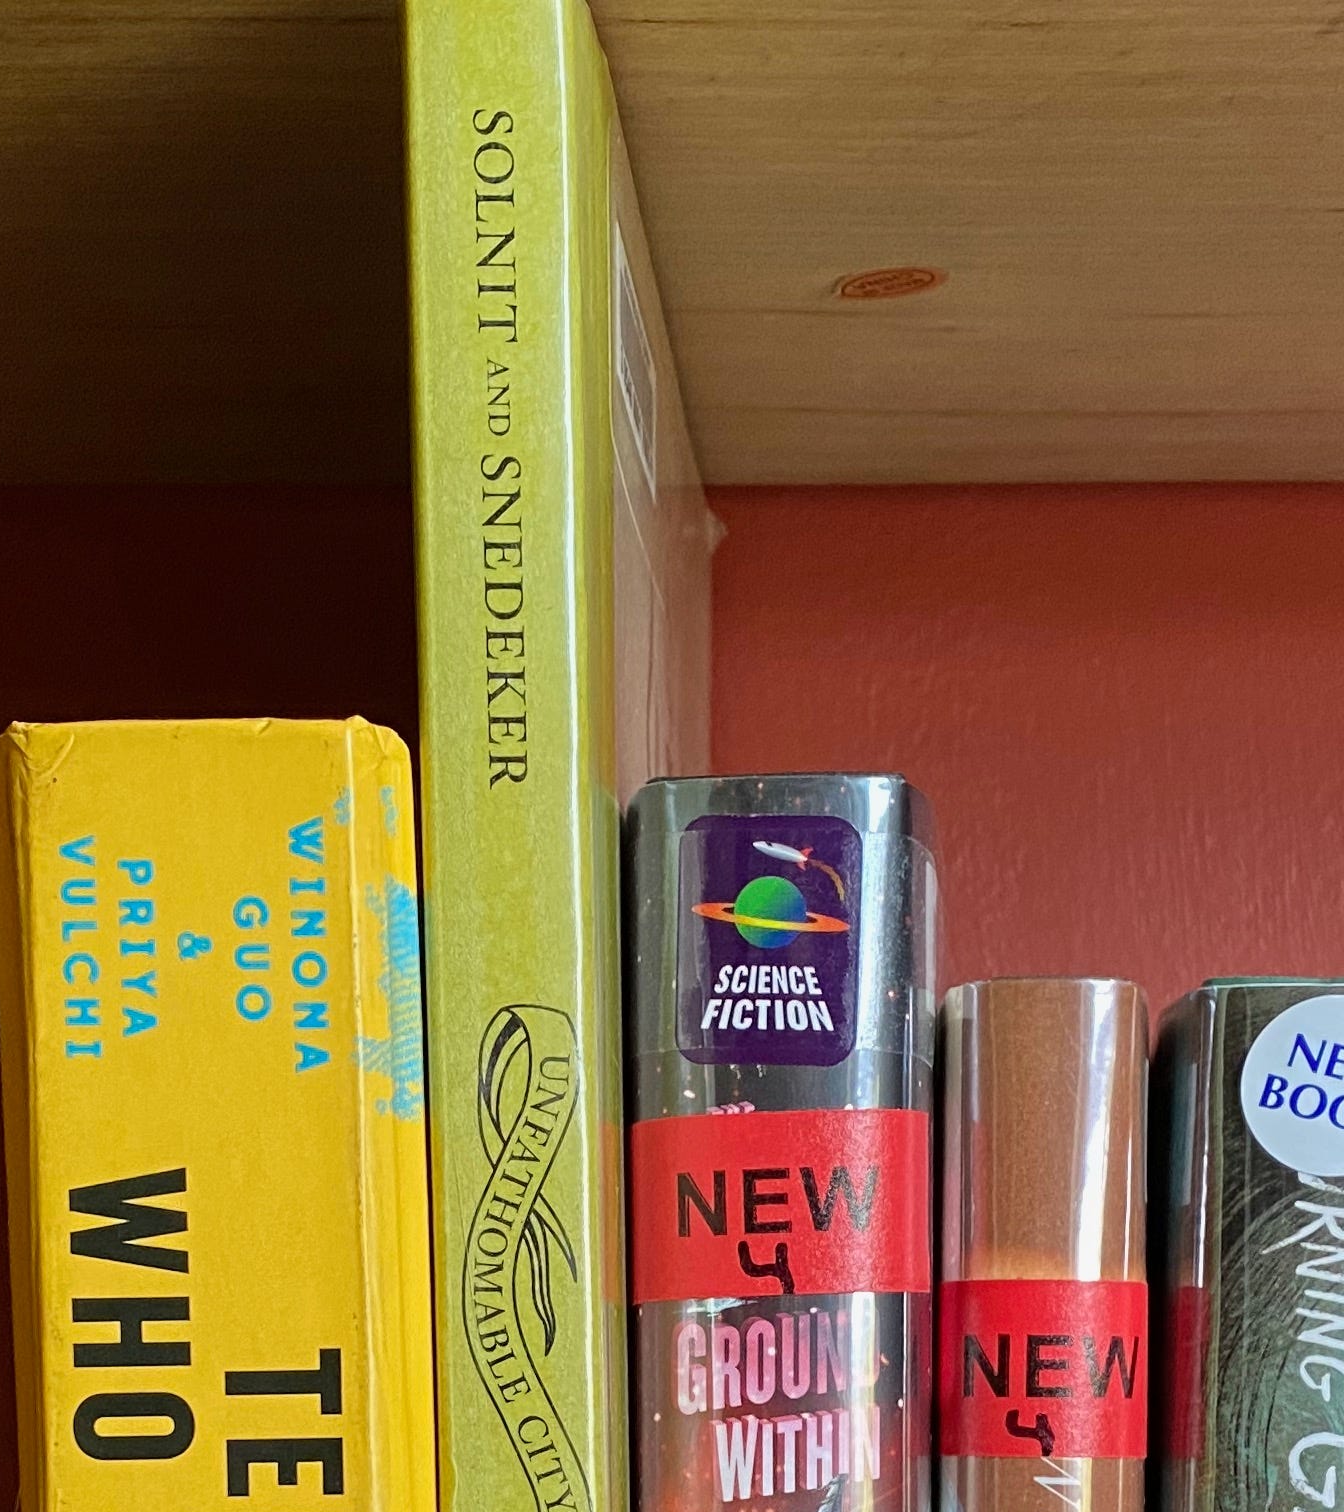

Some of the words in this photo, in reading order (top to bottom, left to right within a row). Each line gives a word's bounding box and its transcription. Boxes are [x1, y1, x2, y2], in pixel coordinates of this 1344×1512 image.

[471, 108, 519, 344] SOLNIT
[486, 358, 511, 437] AND
[479, 453, 528, 787] SNEDEKER
[58, 834, 103, 1059] VULCHI
[117, 858, 157, 1037] PRIYA
[176, 931, 213, 960] &
[233, 896, 272, 1023] GUO
[288, 816, 329, 1073] WINONA
[714, 963, 822, 996] SCIENCE
[700, 999, 835, 1032] FICTION
[474, 1052, 570, 1404] UNFATHOMABLE
[677, 1163, 881, 1238] NEW
[69, 1167, 196, 1461] WHO
[963, 1332, 1139, 1399] NEW
[710, 1405, 881, 1502] WITHIN
